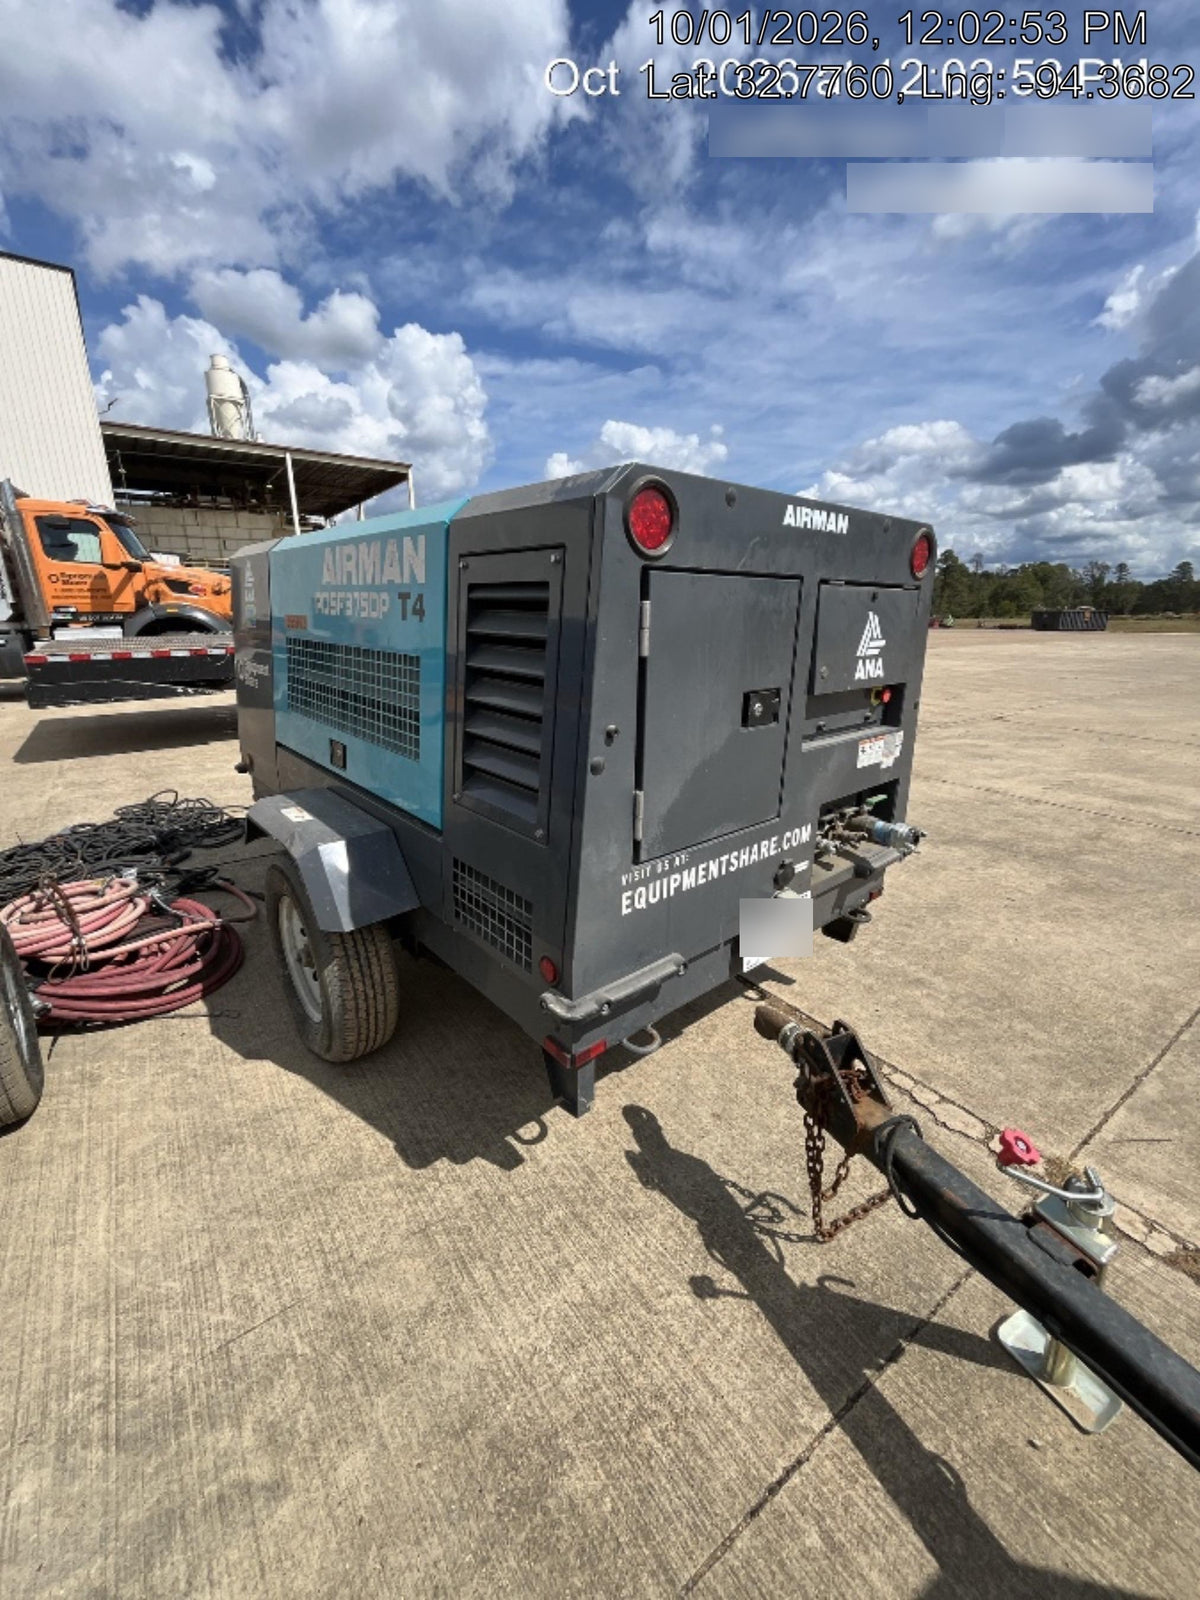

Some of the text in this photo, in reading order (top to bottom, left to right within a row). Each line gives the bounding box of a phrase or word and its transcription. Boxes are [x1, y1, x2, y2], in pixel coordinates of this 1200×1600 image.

[783, 504, 849, 535] AIRMAN
[321, 534, 426, 586] AIRMAN
[397, 591, 426, 623] T4
[854, 657, 884, 681] ANA
[621, 823, 812, 916] EQUIPMENTSHARE.COM
[621, 867, 651, 886] VISIT
